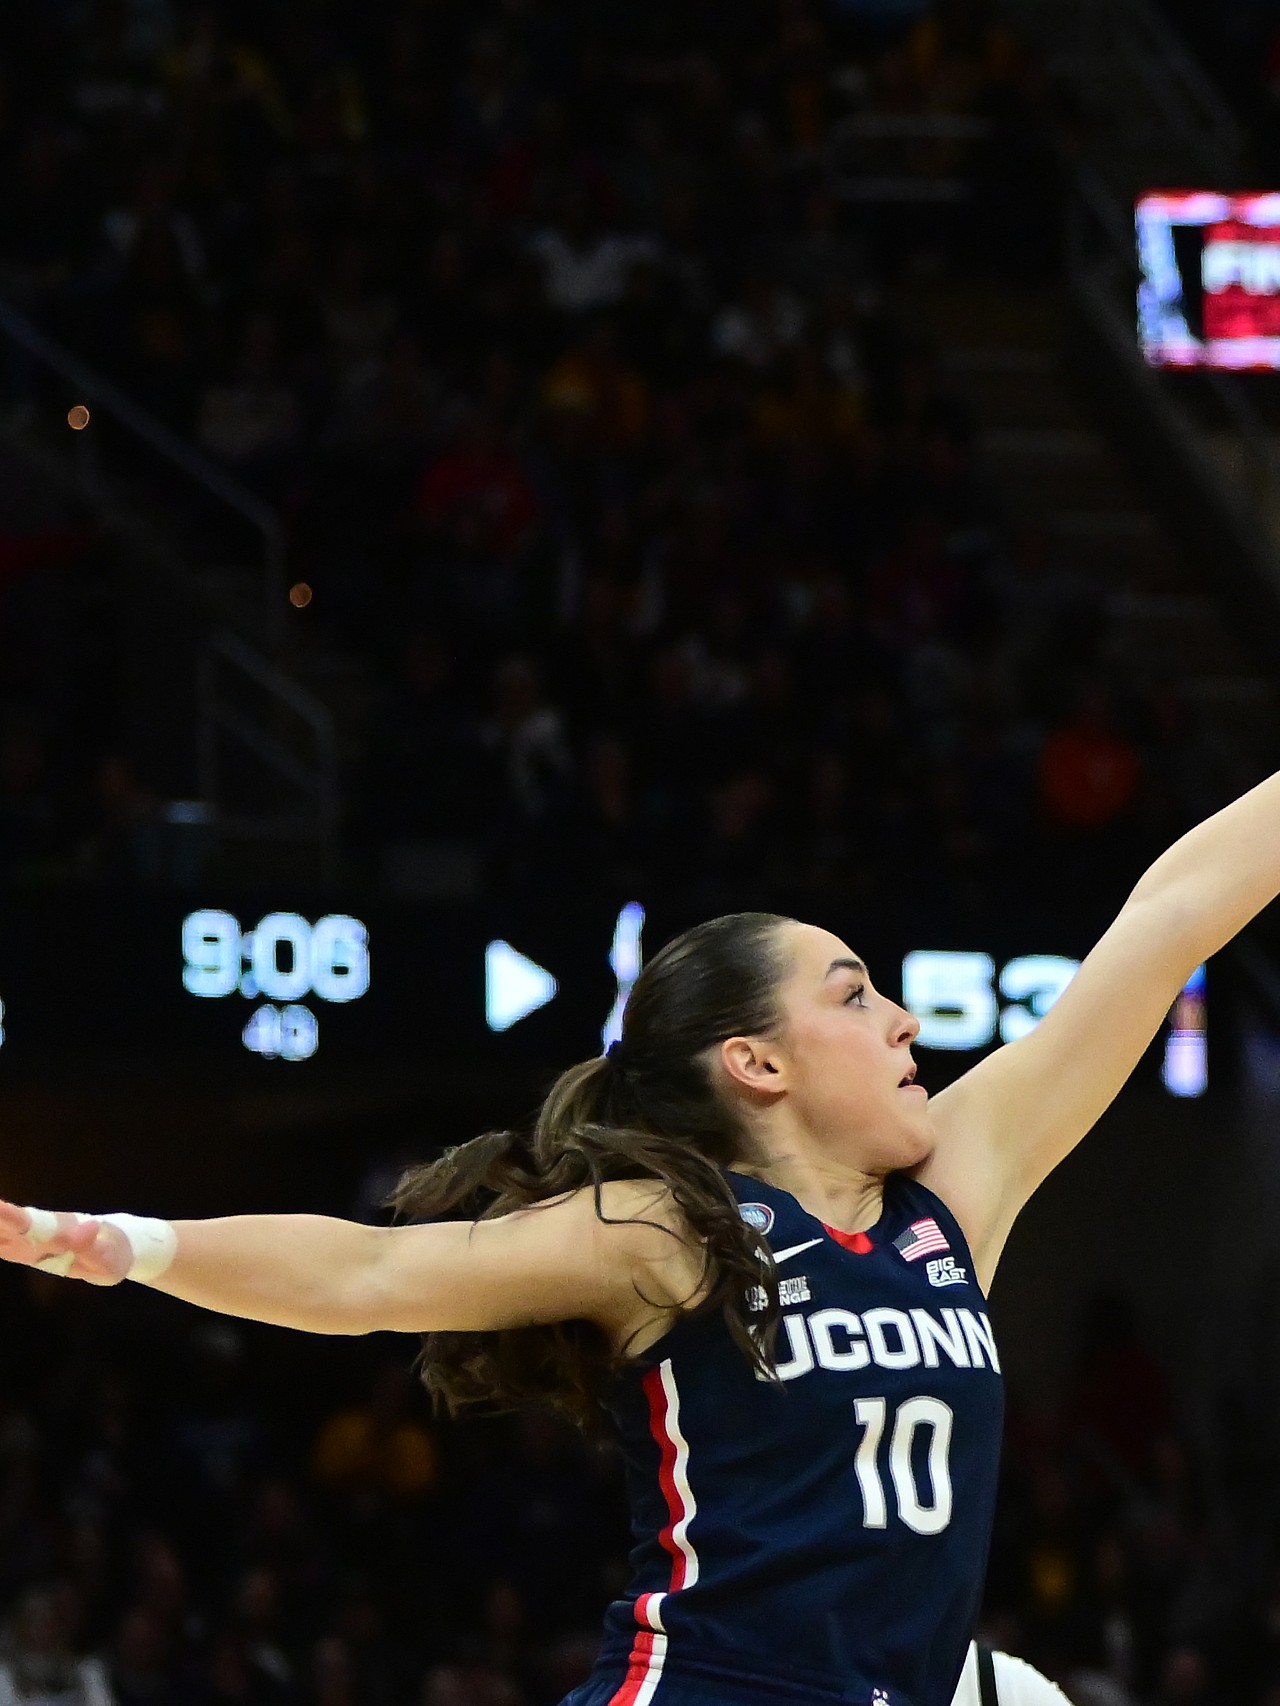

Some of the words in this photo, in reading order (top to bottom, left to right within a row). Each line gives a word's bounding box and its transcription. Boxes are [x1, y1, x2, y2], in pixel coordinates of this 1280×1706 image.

[182, 908, 370, 1003] 9:06
[902, 950, 1083, 1050] 53
[926, 1256, 955, 1275] BIG
[928, 1267, 967, 1283] EAST
[750, 1307, 1001, 1382] UCONN
[853, 1395, 954, 1536] 10
